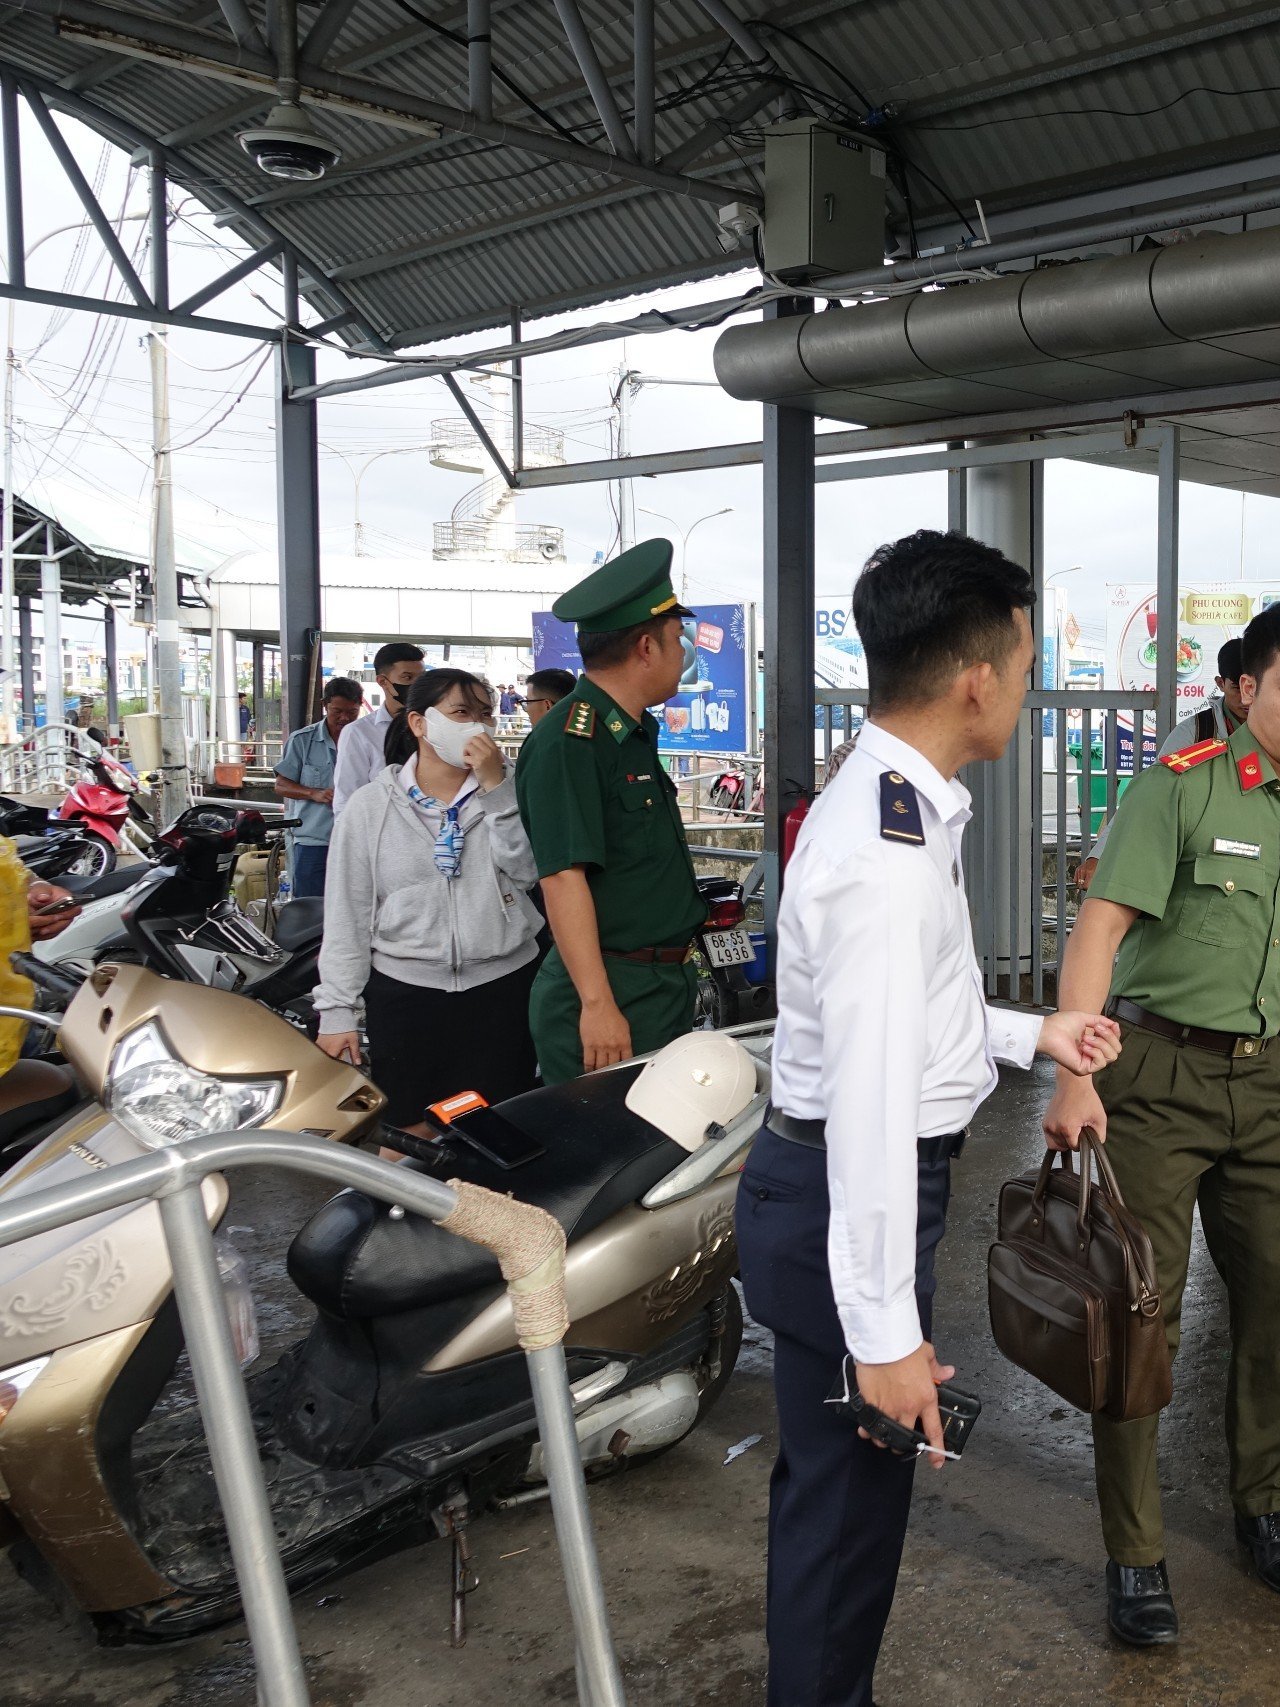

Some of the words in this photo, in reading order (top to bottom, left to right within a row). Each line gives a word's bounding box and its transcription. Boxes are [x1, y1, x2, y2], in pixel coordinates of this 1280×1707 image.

[1192, 599, 1211, 607] PHU
[1212, 599, 1243, 607] CUONG
[1184, 685, 1206, 698] 69K
[717, 945, 749, 963] 4936
